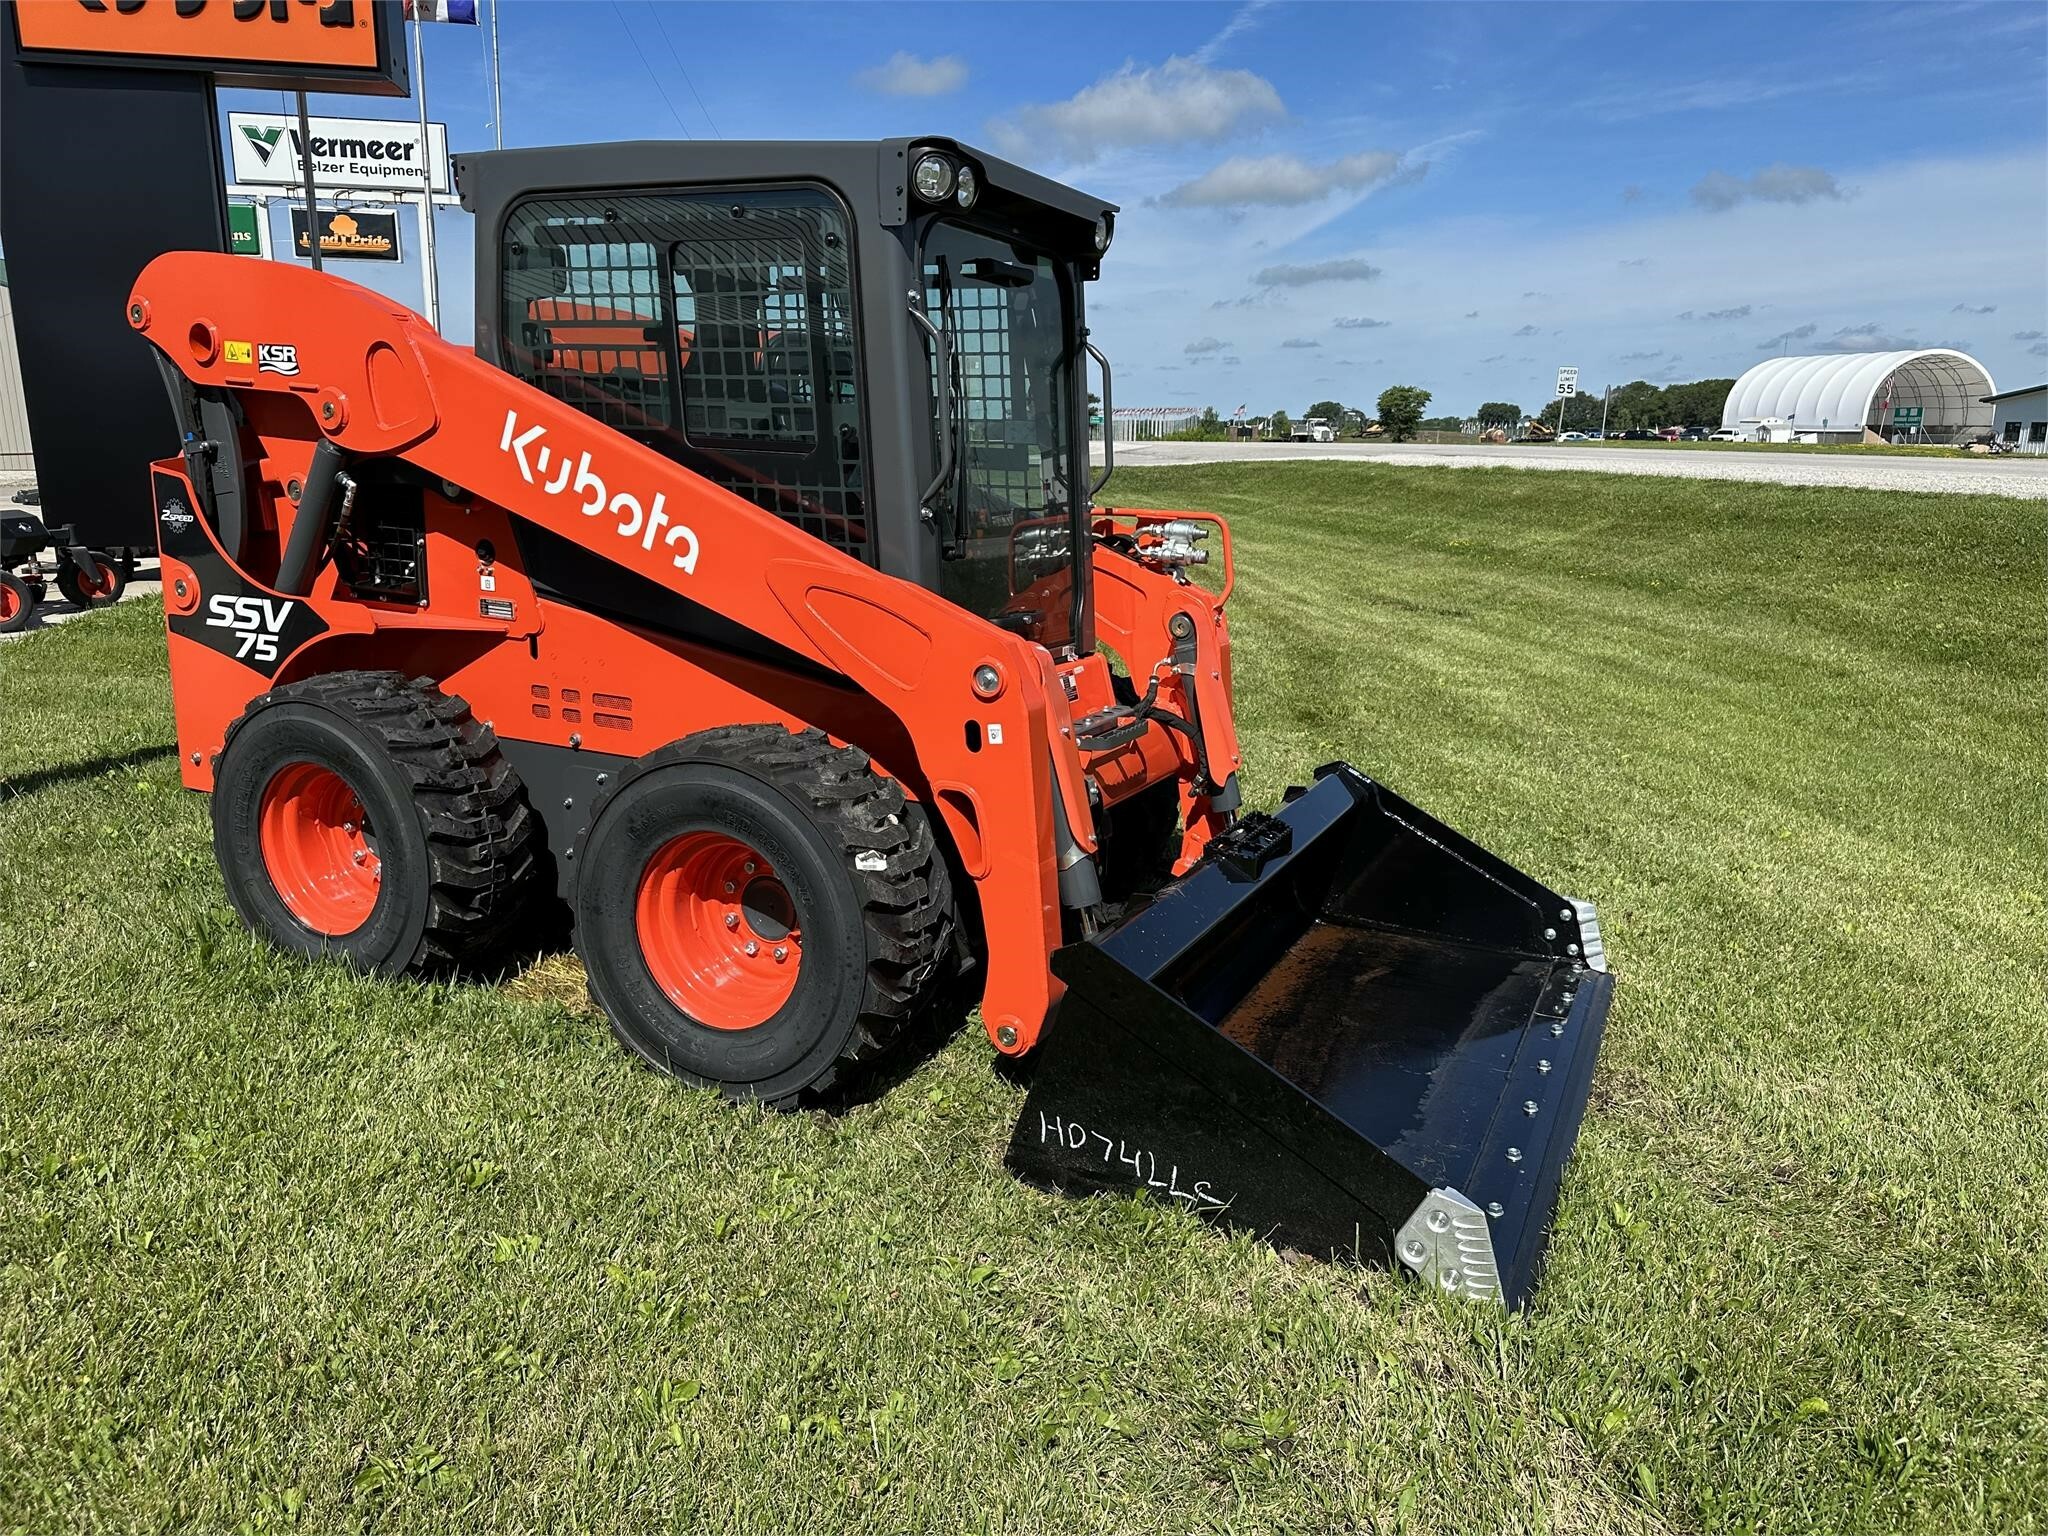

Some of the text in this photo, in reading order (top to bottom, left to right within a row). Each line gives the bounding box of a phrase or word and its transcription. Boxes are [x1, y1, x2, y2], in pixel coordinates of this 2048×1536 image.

[289, 129, 414, 160] Vermeer
[349, 162, 424, 178] Equipmen
[302, 231, 390, 246] Lnd Pride
[258, 344, 297, 362] KSR
[1558, 384, 1574, 394] 55
[500, 409, 700, 576] Kubota
[205, 594, 294, 633] SSV
[235, 632, 279, 662] 75
